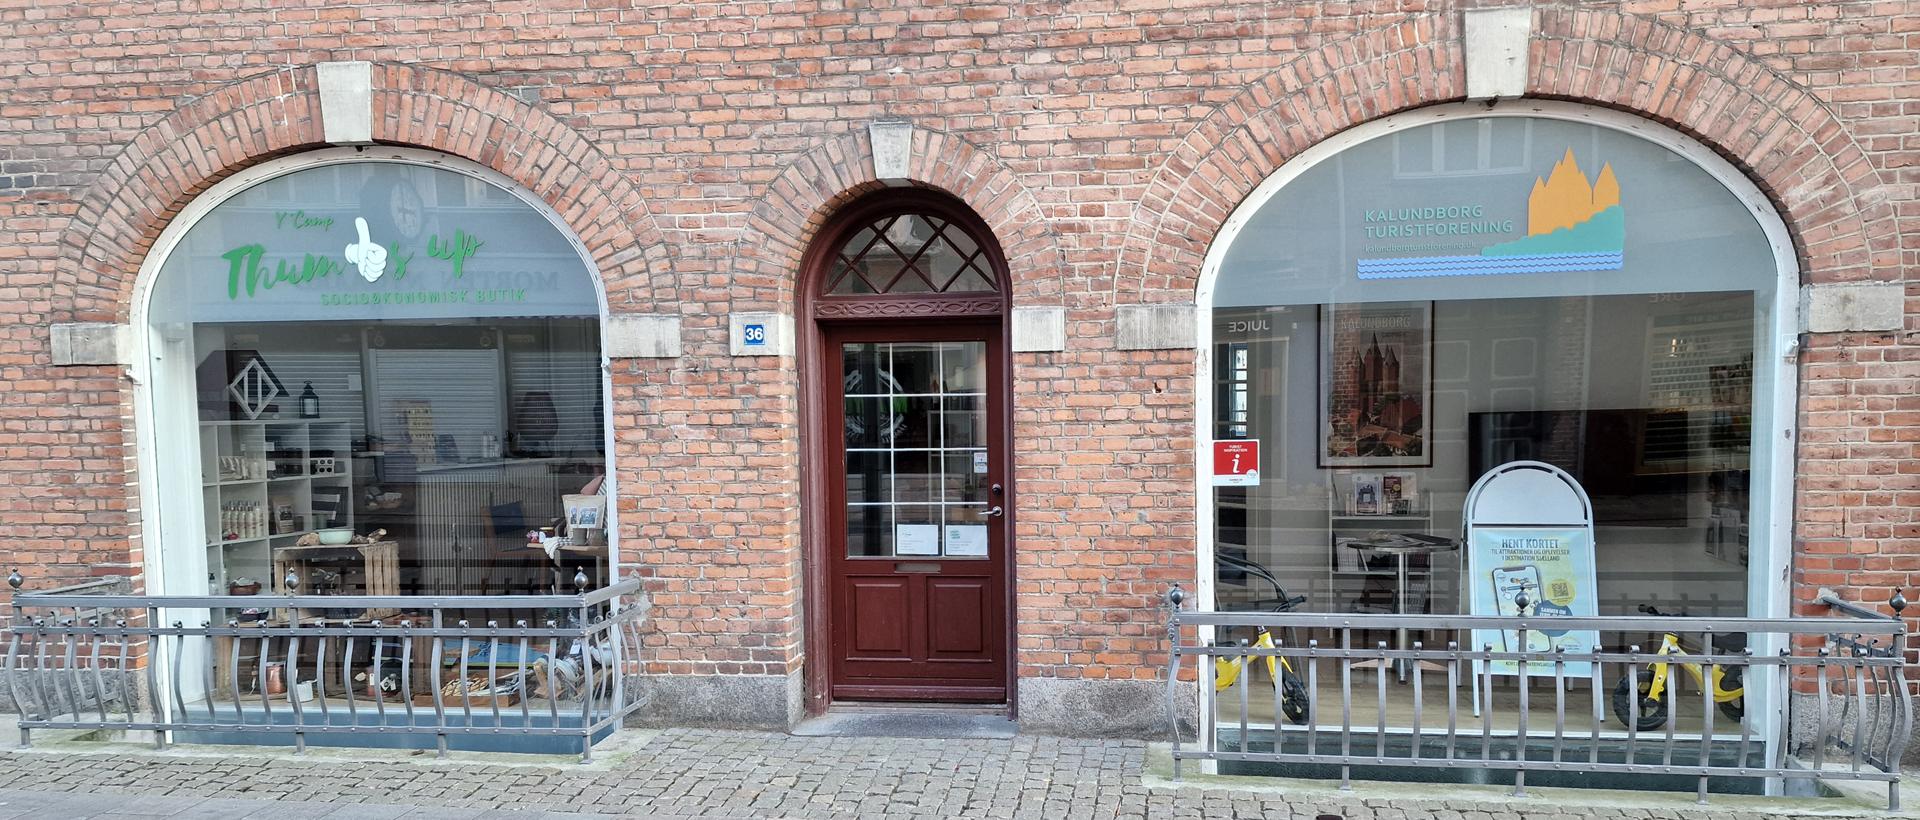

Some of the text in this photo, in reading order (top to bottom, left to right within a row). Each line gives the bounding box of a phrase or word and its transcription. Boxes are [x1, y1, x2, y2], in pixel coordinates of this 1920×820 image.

[1364, 205, 1484, 223] KALUNDBORG
[1364, 219, 1514, 239] TURISTFORENING
[427, 227, 485, 279] up
[320, 288, 527, 305] SOCIOØKONOMISK BUTIK
[1341, 316, 1411, 329] KALUNDBORG
[746, 327, 763, 340] 36
[1502, 538, 1559, 549] HENT KORTET
